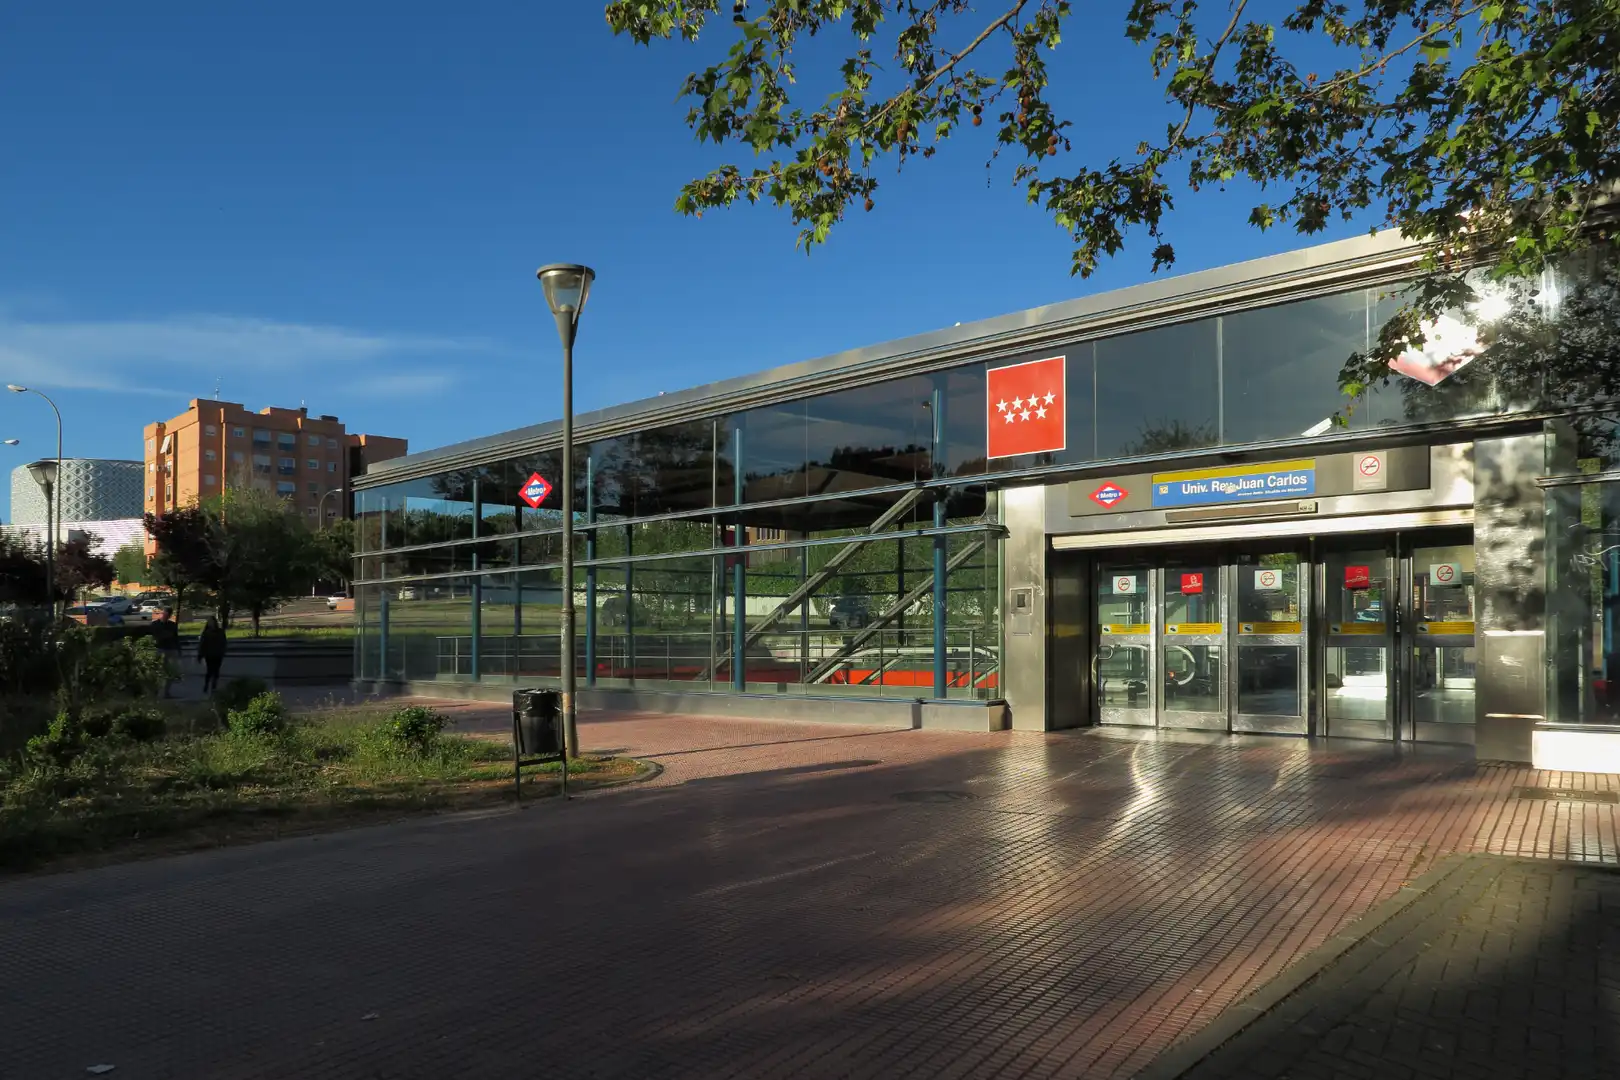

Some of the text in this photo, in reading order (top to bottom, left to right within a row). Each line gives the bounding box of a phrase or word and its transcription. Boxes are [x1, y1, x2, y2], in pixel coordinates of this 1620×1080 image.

[1182, 482, 1208, 494] Univ.
[1236, 478, 1264, 489] Juan
[1267, 473, 1307, 487] Carlos
[527, 487, 544, 496] Metro
